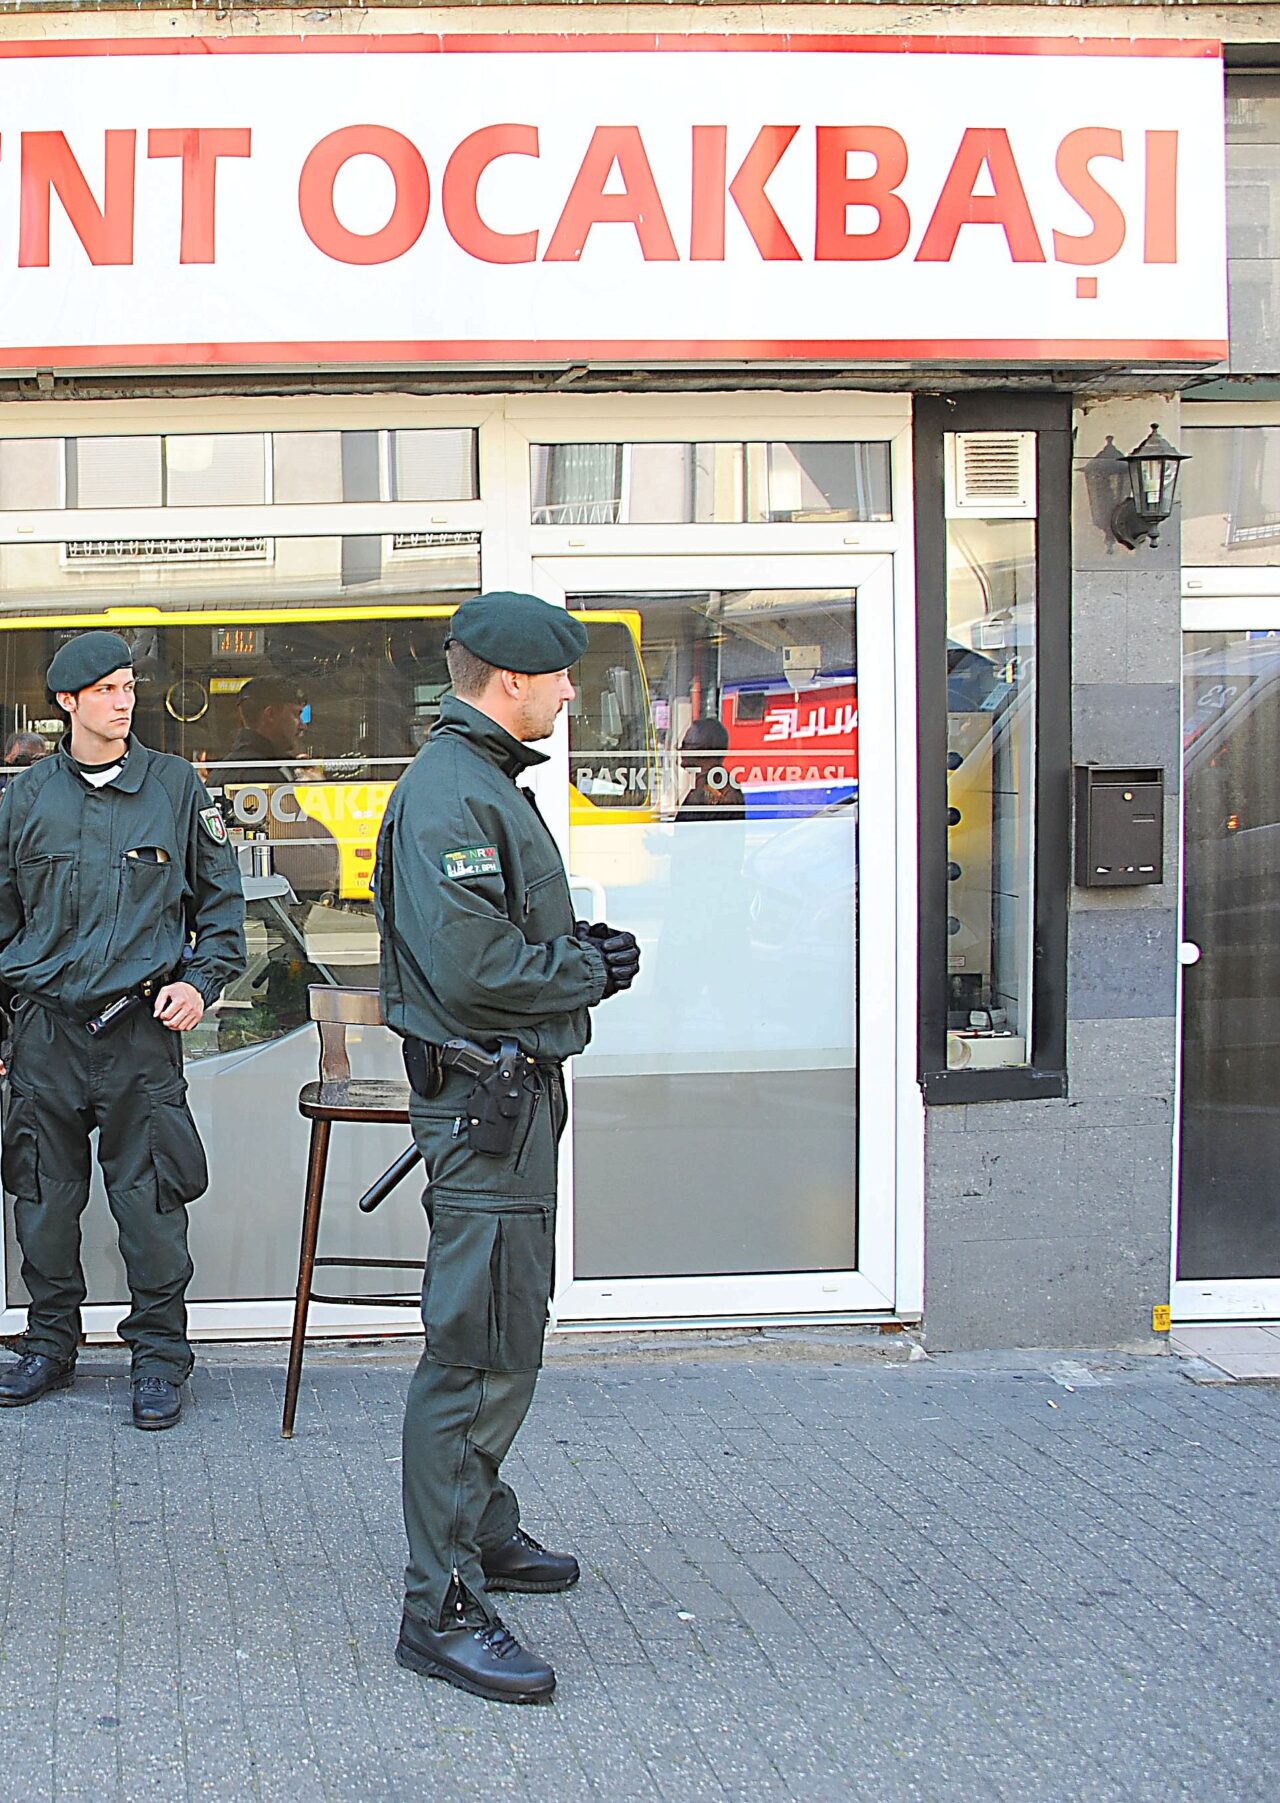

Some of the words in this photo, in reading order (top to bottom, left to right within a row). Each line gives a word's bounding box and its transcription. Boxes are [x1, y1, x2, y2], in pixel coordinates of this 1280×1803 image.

[298, 122, 1179, 300] OCAKBAŞI
[233, 785, 392, 824] OCAKB
[469, 847, 495, 858] NRW
